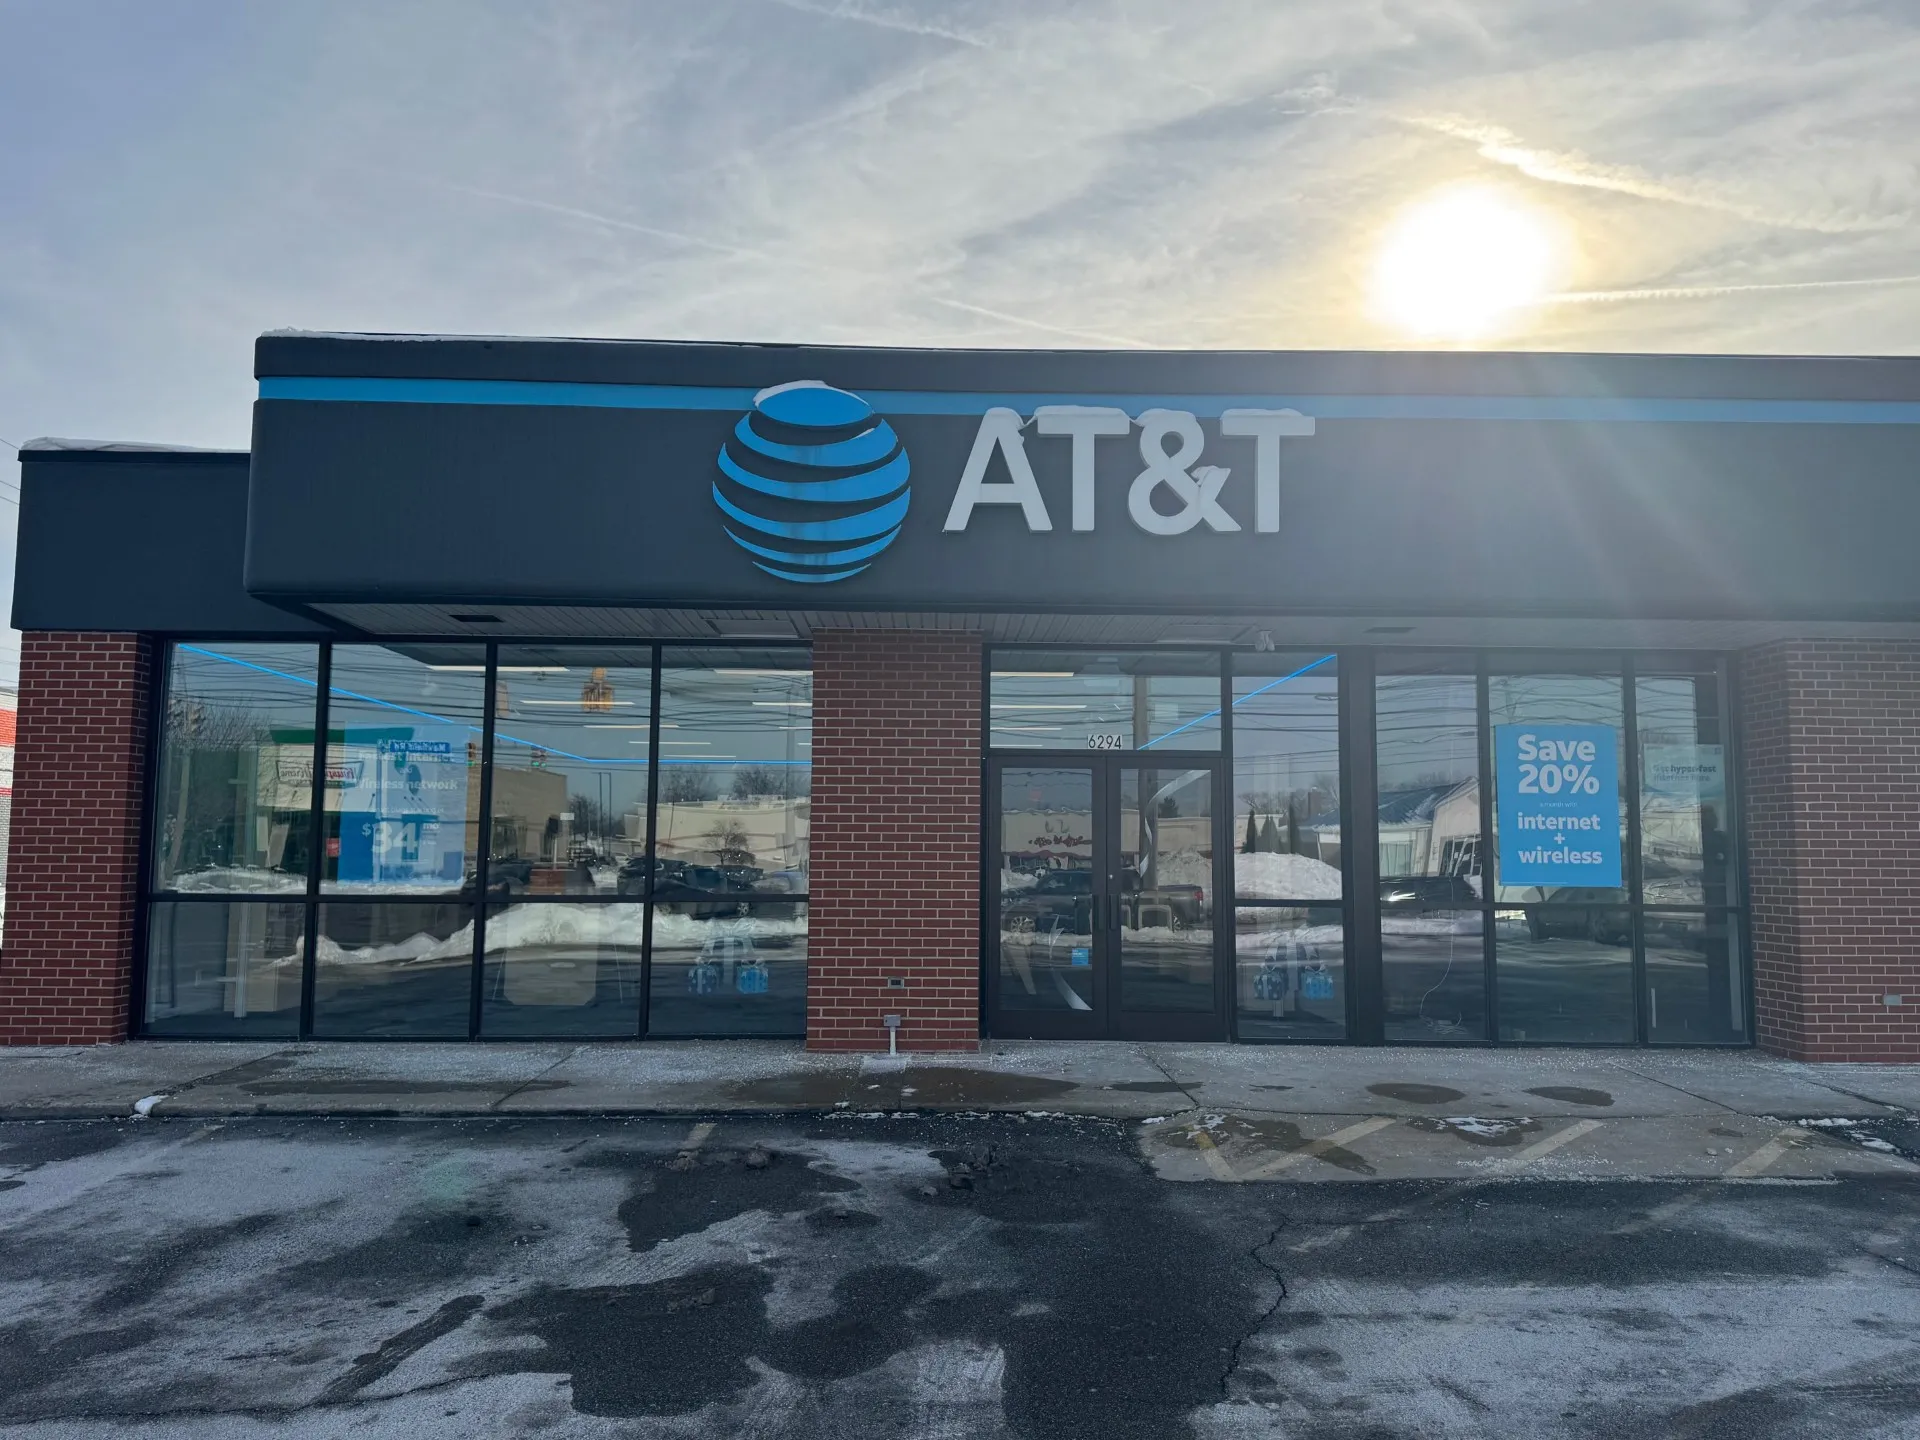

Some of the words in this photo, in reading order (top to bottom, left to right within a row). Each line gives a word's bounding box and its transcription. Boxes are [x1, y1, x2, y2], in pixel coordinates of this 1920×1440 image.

[942, 407, 1316, 536] AT&T
[1088, 735, 1122, 749] 6294
[1517, 734, 1596, 762] Save
[407, 779, 458, 789] network
[1518, 763, 1600, 795] 20%
[1517, 812, 1601, 830] internet
[1517, 846, 1603, 864] wireless
